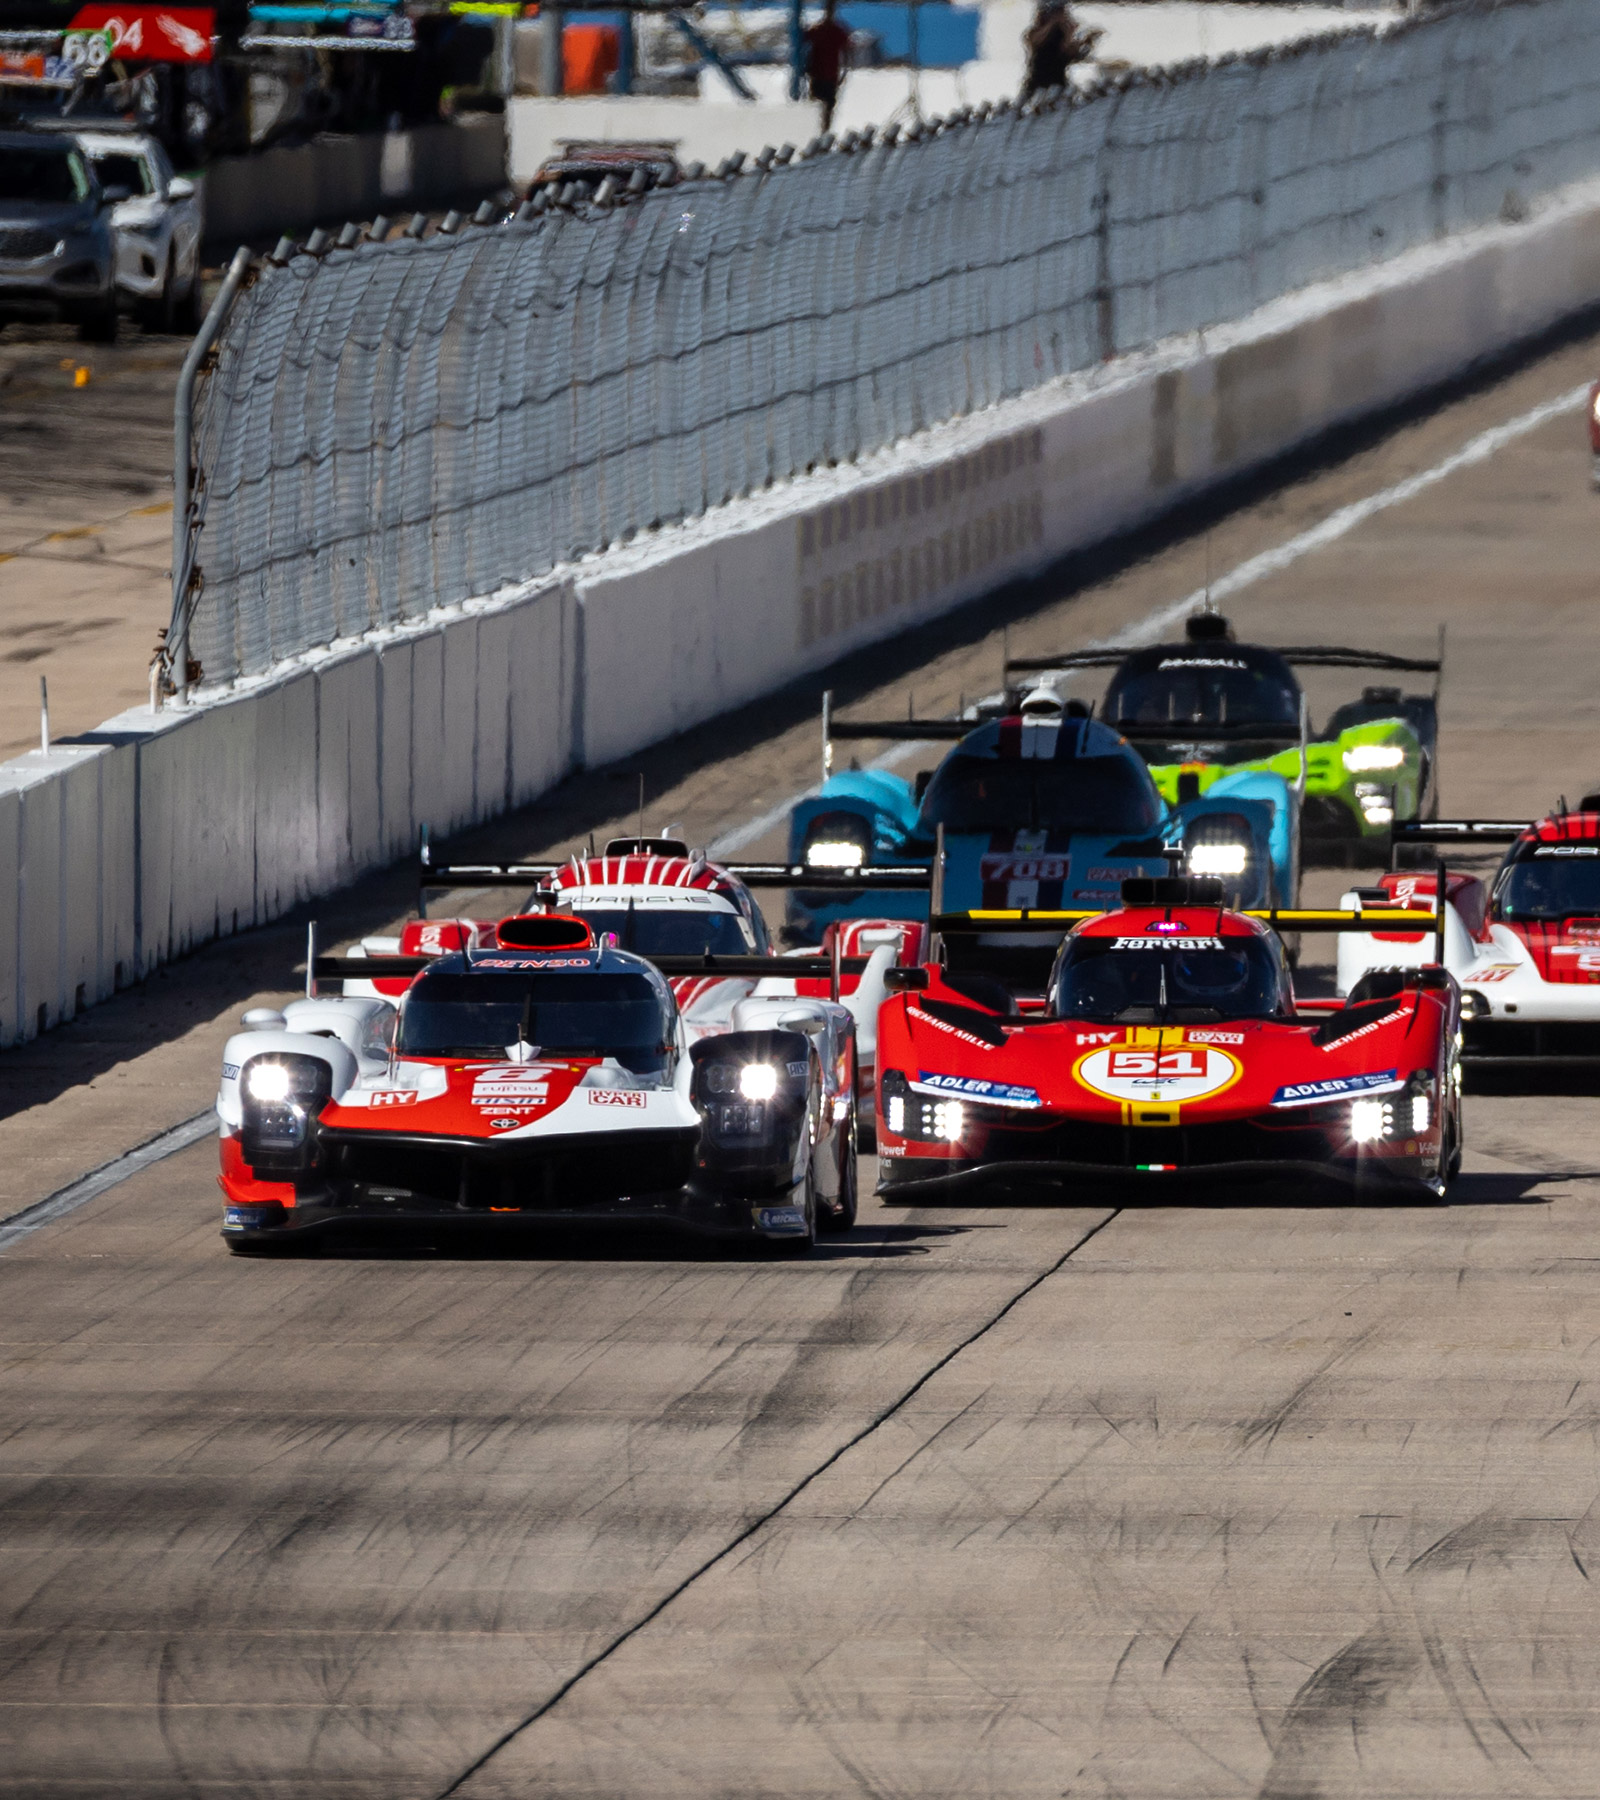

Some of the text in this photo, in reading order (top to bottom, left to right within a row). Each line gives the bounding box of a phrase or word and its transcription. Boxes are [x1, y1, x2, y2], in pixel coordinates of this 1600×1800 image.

[988, 860, 1066, 881] 708
[1110, 937, 1225, 950] Ferrari
[472, 958, 590, 968] DENSO
[906, 1006, 995, 1051] RICHARD MILLE
[1322, 1006, 1415, 1052] RICHARD MILLE
[1076, 1032, 1117, 1045] HY
[1113, 1051, 1203, 1074] 51
[475, 1068, 552, 1081] 8
[923, 1075, 992, 1093] ADLER
[1284, 1080, 1349, 1098] ADLER
[372, 1091, 415, 1106] HY
[593, 1095, 641, 1106] CAR
[480, 1106, 535, 1115] ZENT
